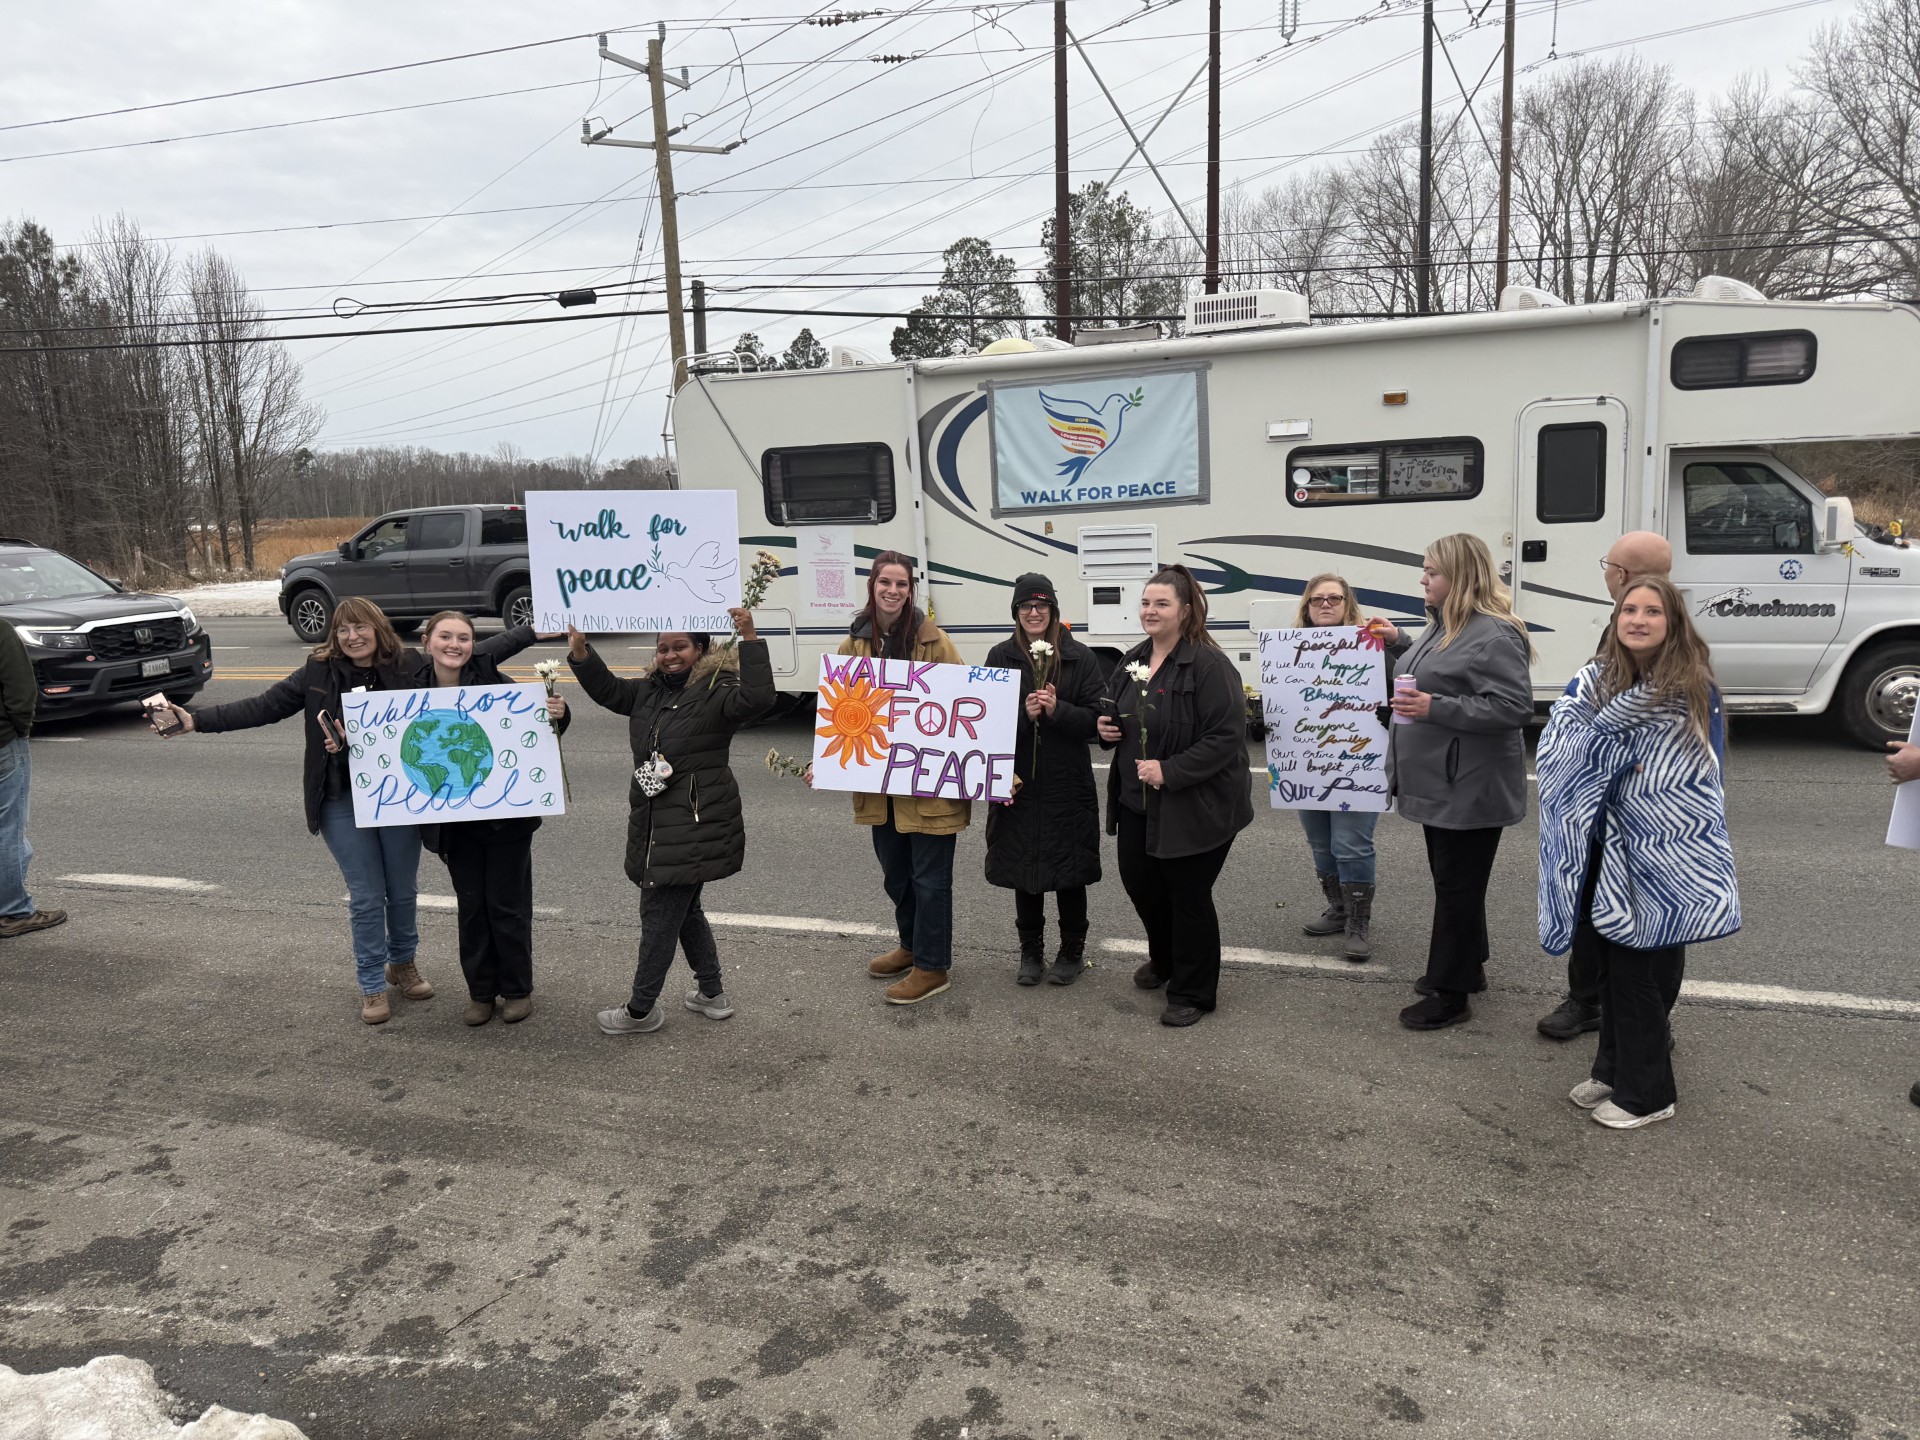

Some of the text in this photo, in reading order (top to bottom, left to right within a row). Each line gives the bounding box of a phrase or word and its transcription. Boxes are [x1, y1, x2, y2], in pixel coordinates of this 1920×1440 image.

[1060, 432, 1102, 445] LOVING-KINDNESS
[1068, 425, 1101, 435] COMPASSION
[1020, 481, 1177, 505] WALK FOR PEACE
[549, 508, 688, 543] walk for
[555, 563, 653, 609] peace
[1715, 598, 1836, 617] Coachmen
[615, 616, 673, 631] VIRGINIA
[1312, 631, 1334, 639] are
[1294, 633, 1362, 667] peaceful
[822, 653, 939, 694] WALK
[1321, 655, 1375, 685] happy
[1299, 686, 1365, 702] Blossom
[345, 688, 535, 729] Walk for
[887, 696, 987, 740] FOR
[1265, 698, 1289, 715] like
[1319, 700, 1382, 719] flower
[1294, 718, 1360, 740] Everyone
[1317, 734, 1373, 753] family
[881, 742, 1016, 802] PEACE
[1306, 759, 1345, 776] benefit
[367, 768, 534, 821] Peace
